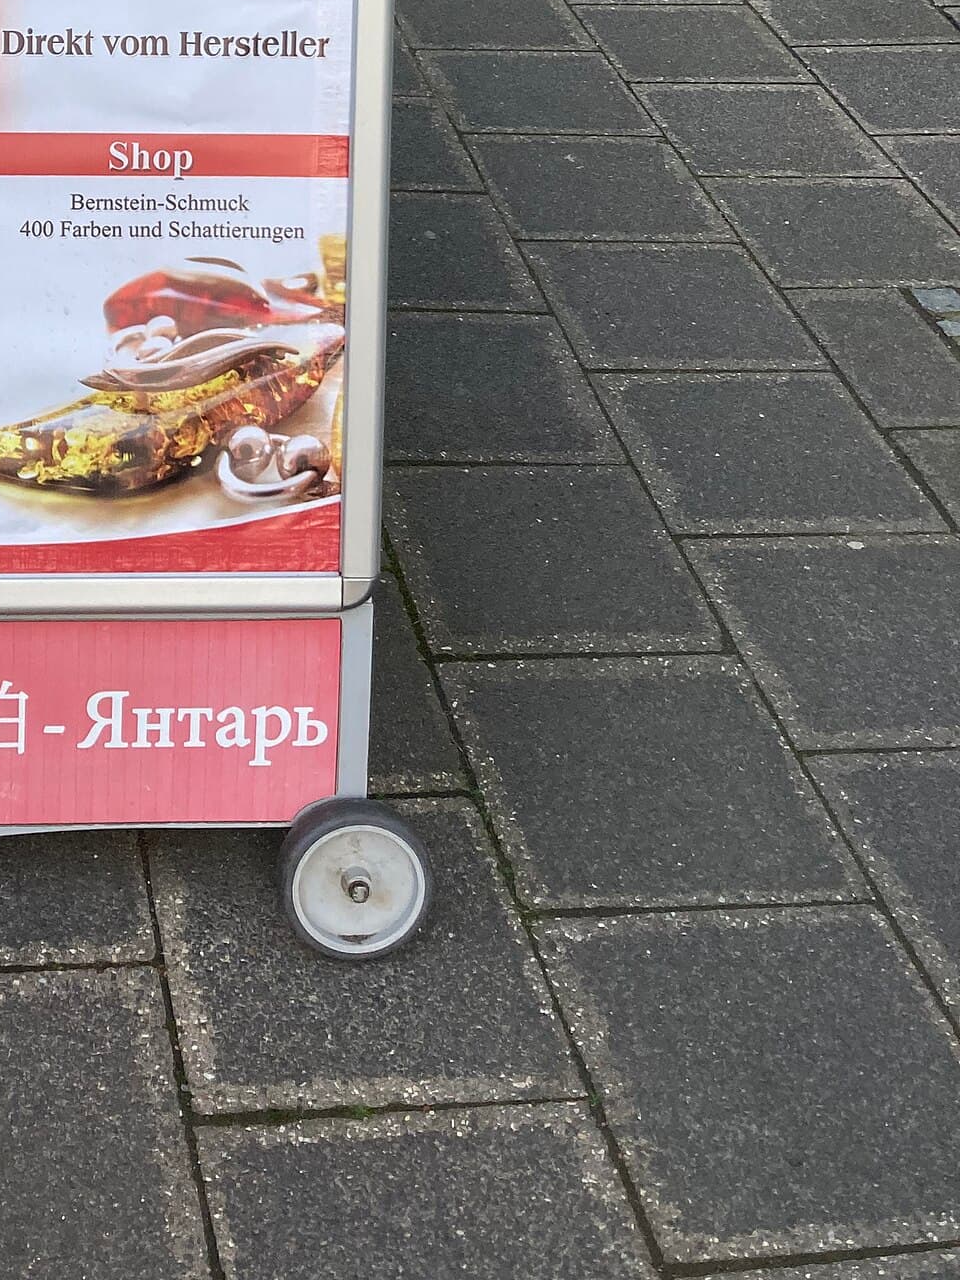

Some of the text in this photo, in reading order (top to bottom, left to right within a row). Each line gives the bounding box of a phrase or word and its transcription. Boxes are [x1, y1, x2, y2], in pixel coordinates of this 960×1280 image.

[2, 28, 329, 57] Direkt vom Hersteller
[109, 141, 193, 180] Shop
[71, 194, 249, 211] Bernstein-Schmuck
[20, 221, 304, 240] 400 Farben und Schattierungen
[77, 691, 328, 766] Янтарь
